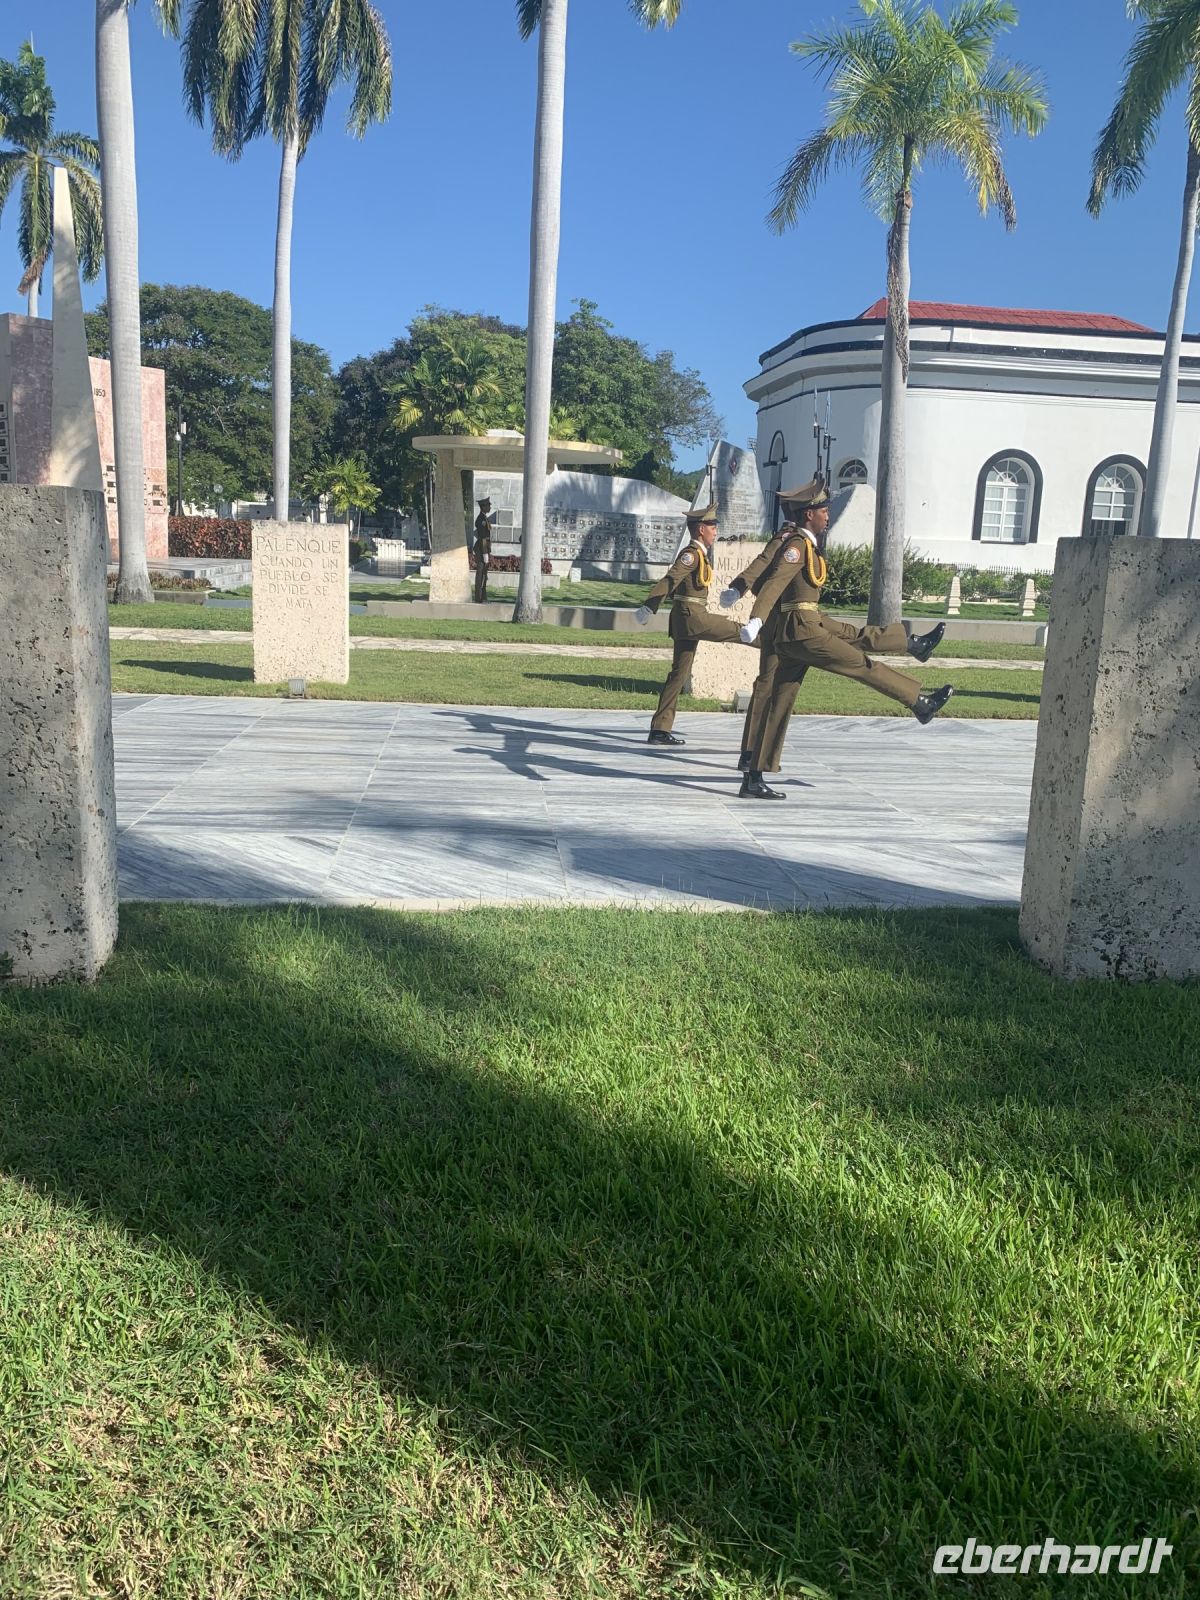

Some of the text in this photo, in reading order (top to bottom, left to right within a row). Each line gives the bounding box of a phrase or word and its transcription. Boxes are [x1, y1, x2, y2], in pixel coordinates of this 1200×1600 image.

[255, 535, 341, 554] PALENQUE
[259, 555, 339, 570] CUANDO UN
[717, 557, 752, 571] MIJIA
[260, 569, 339, 584] PUEBLO SE
[268, 583, 330, 597] DIVIDE SE
[285, 597, 313, 609] MATA
